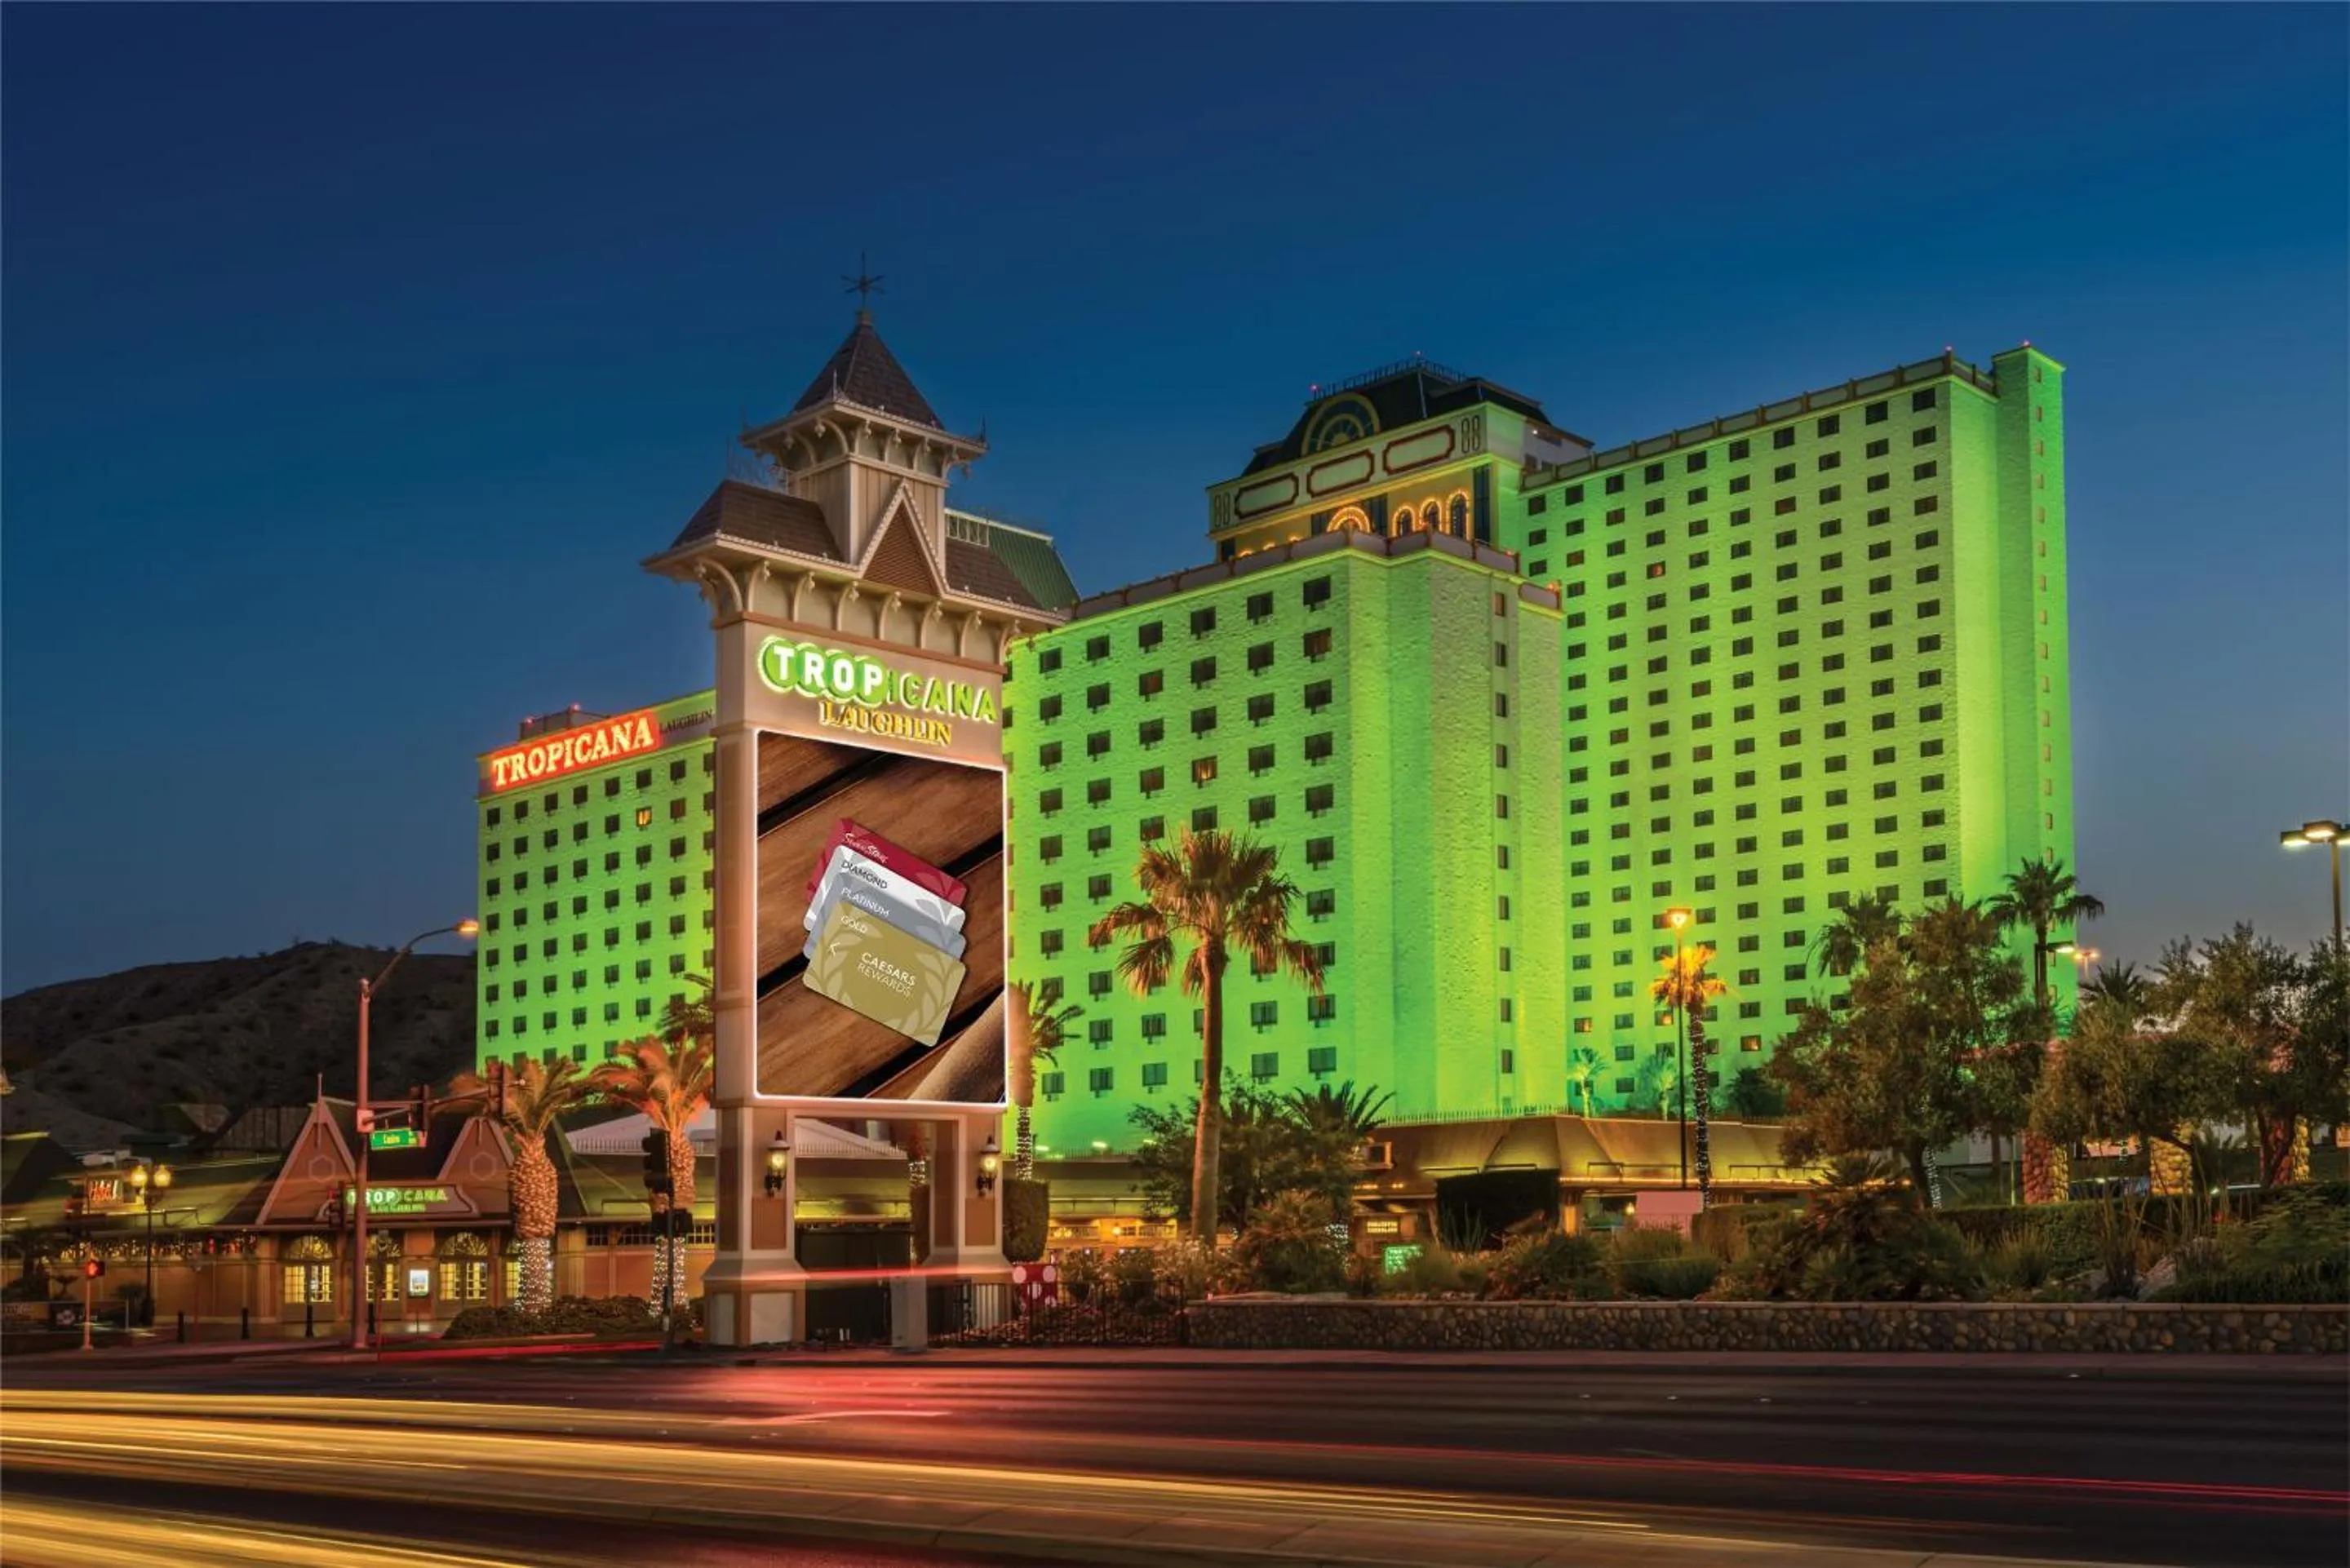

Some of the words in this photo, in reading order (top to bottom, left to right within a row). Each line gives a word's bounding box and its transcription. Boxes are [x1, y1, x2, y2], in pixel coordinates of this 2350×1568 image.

[771, 644, 999, 724] TROPICANA
[819, 700, 952, 746] LAUGHLIN
[492, 716, 654, 787] TROPICANA
[841, 860, 888, 889] DIAMOND
[841, 887, 890, 917] PLATINUM
[840, 915, 868, 934] GOLD
[858, 962, 913, 997] REWARDS
[861, 952, 916, 986] CAESARS
